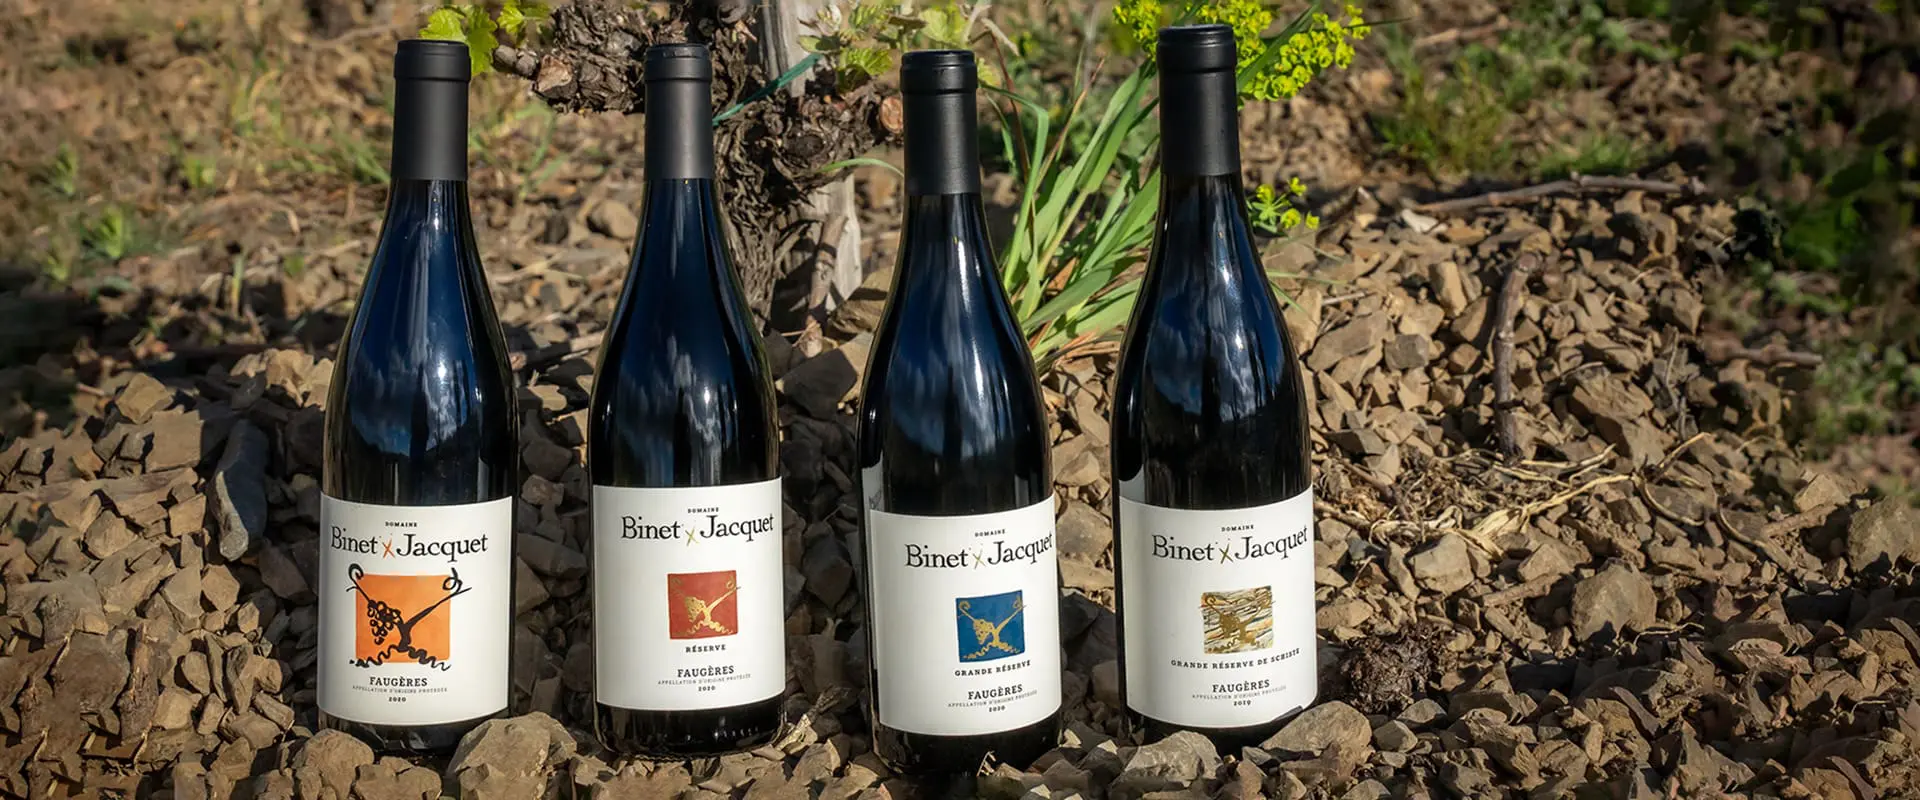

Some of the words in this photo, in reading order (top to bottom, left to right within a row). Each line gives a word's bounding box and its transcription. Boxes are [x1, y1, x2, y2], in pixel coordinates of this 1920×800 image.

[620, 516, 681, 540] Binet
[700, 514, 774, 542] Jacquet
[974, 528, 1006, 537] DOMAINE
[1221, 524, 1254, 532] DOMAINE
[331, 526, 378, 554] Binet
[396, 533, 488, 563] Jacquet
[904, 544, 969, 568] Binet
[986, 531, 1053, 565] Jacquet
[1151, 534, 1214, 561] Binet
[1234, 526, 1308, 560] Jacquet
[685, 644, 726, 653] RÉSERVE
[1170, 660, 1208, 669] GRANDE
[1212, 660, 1254, 670] RÉSERVE
[1257, 658, 1268, 666] DE
[1270, 648, 1300, 663] SCHISTE
[677, 665, 734, 678] FAUGÈRES
[954, 668, 993, 676] GRANDE
[996, 660, 1031, 672] RÉSERVE
[369, 676, 428, 687] FAUGÈRES
[1212, 679, 1270, 693] FAUGÈRES
[968, 684, 1024, 700] FAUGÈRES
